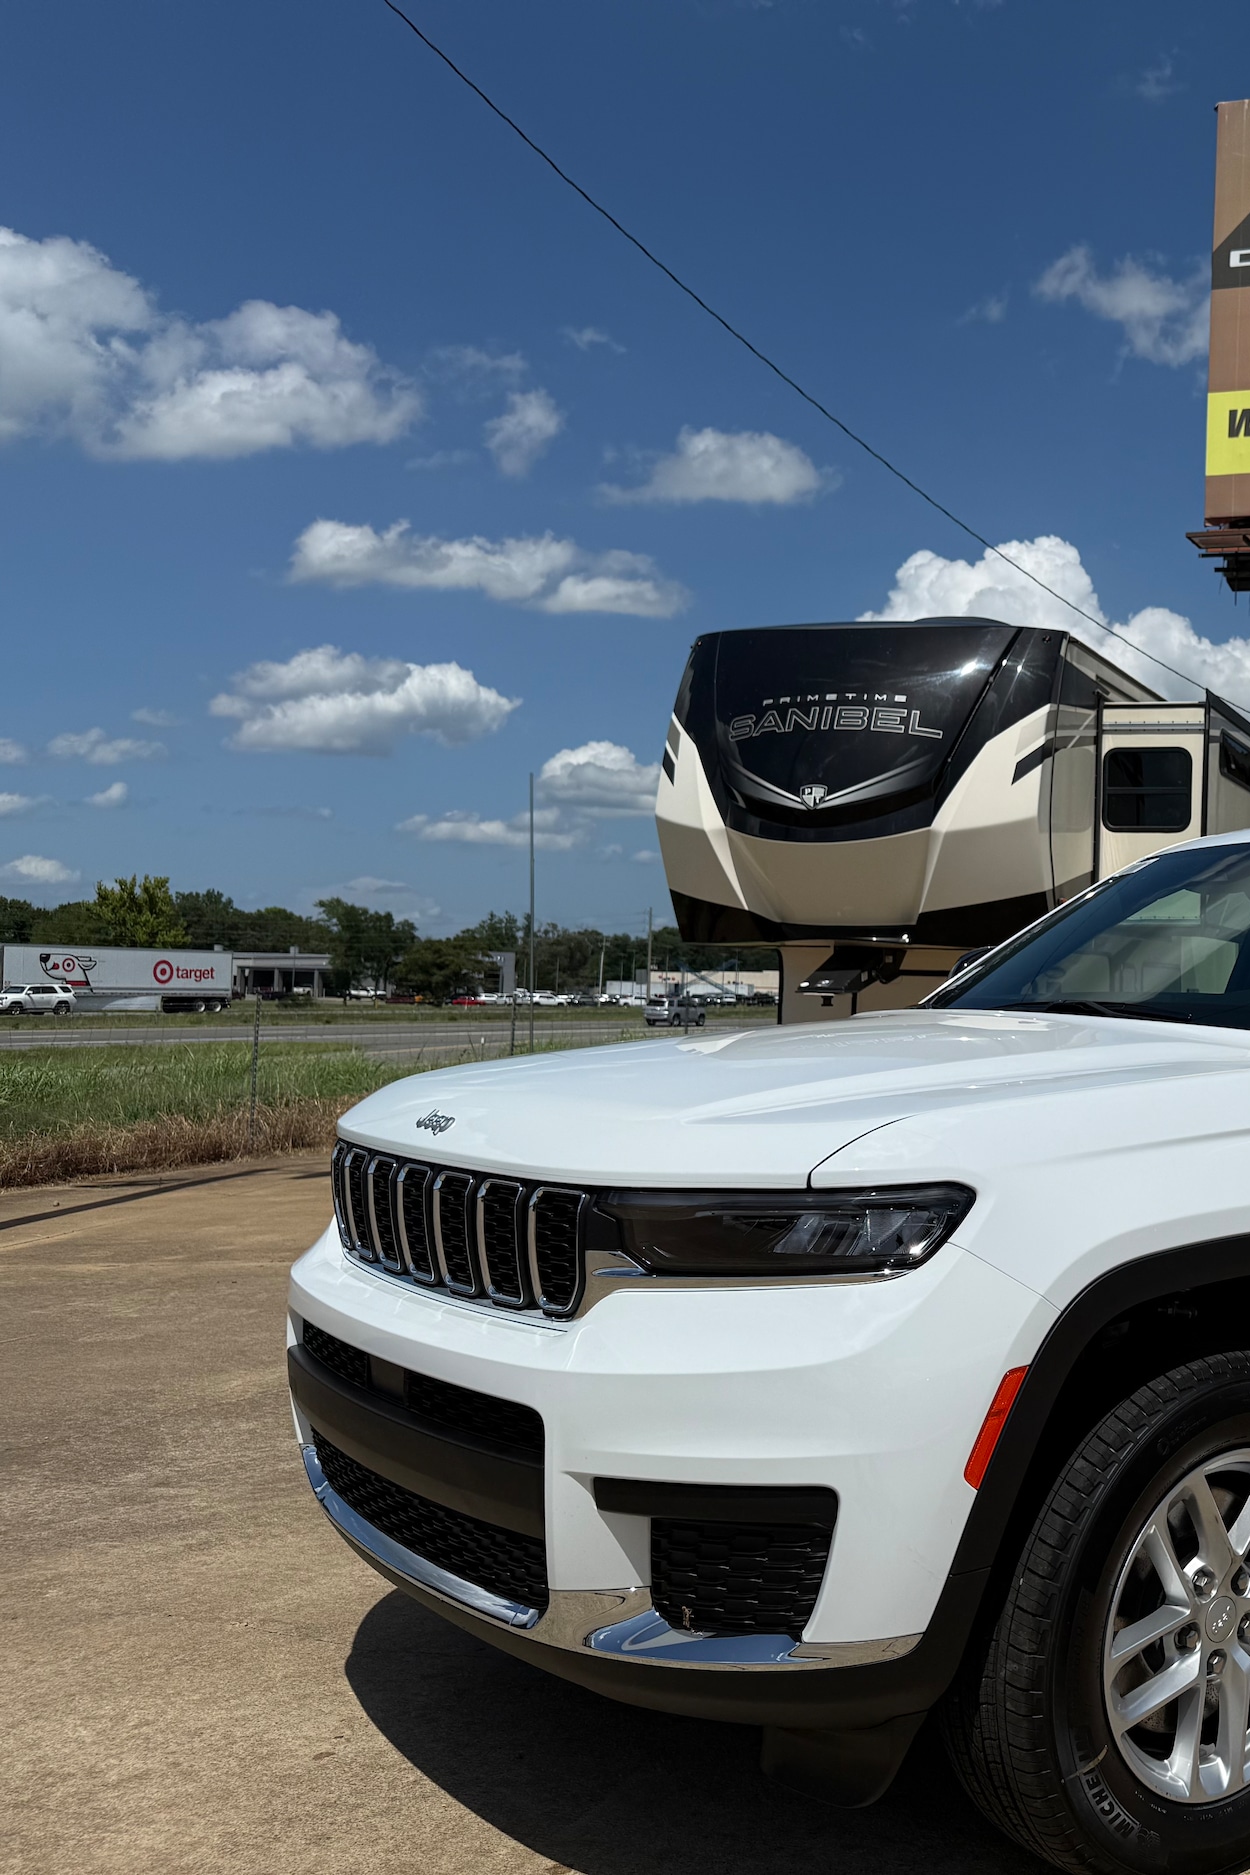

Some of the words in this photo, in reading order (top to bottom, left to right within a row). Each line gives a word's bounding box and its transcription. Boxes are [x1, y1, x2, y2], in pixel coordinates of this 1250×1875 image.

[729, 706, 944, 742] SANIBEL
[175, 966, 215, 983] target
[416, 1109, 456, 1136] Jeep
